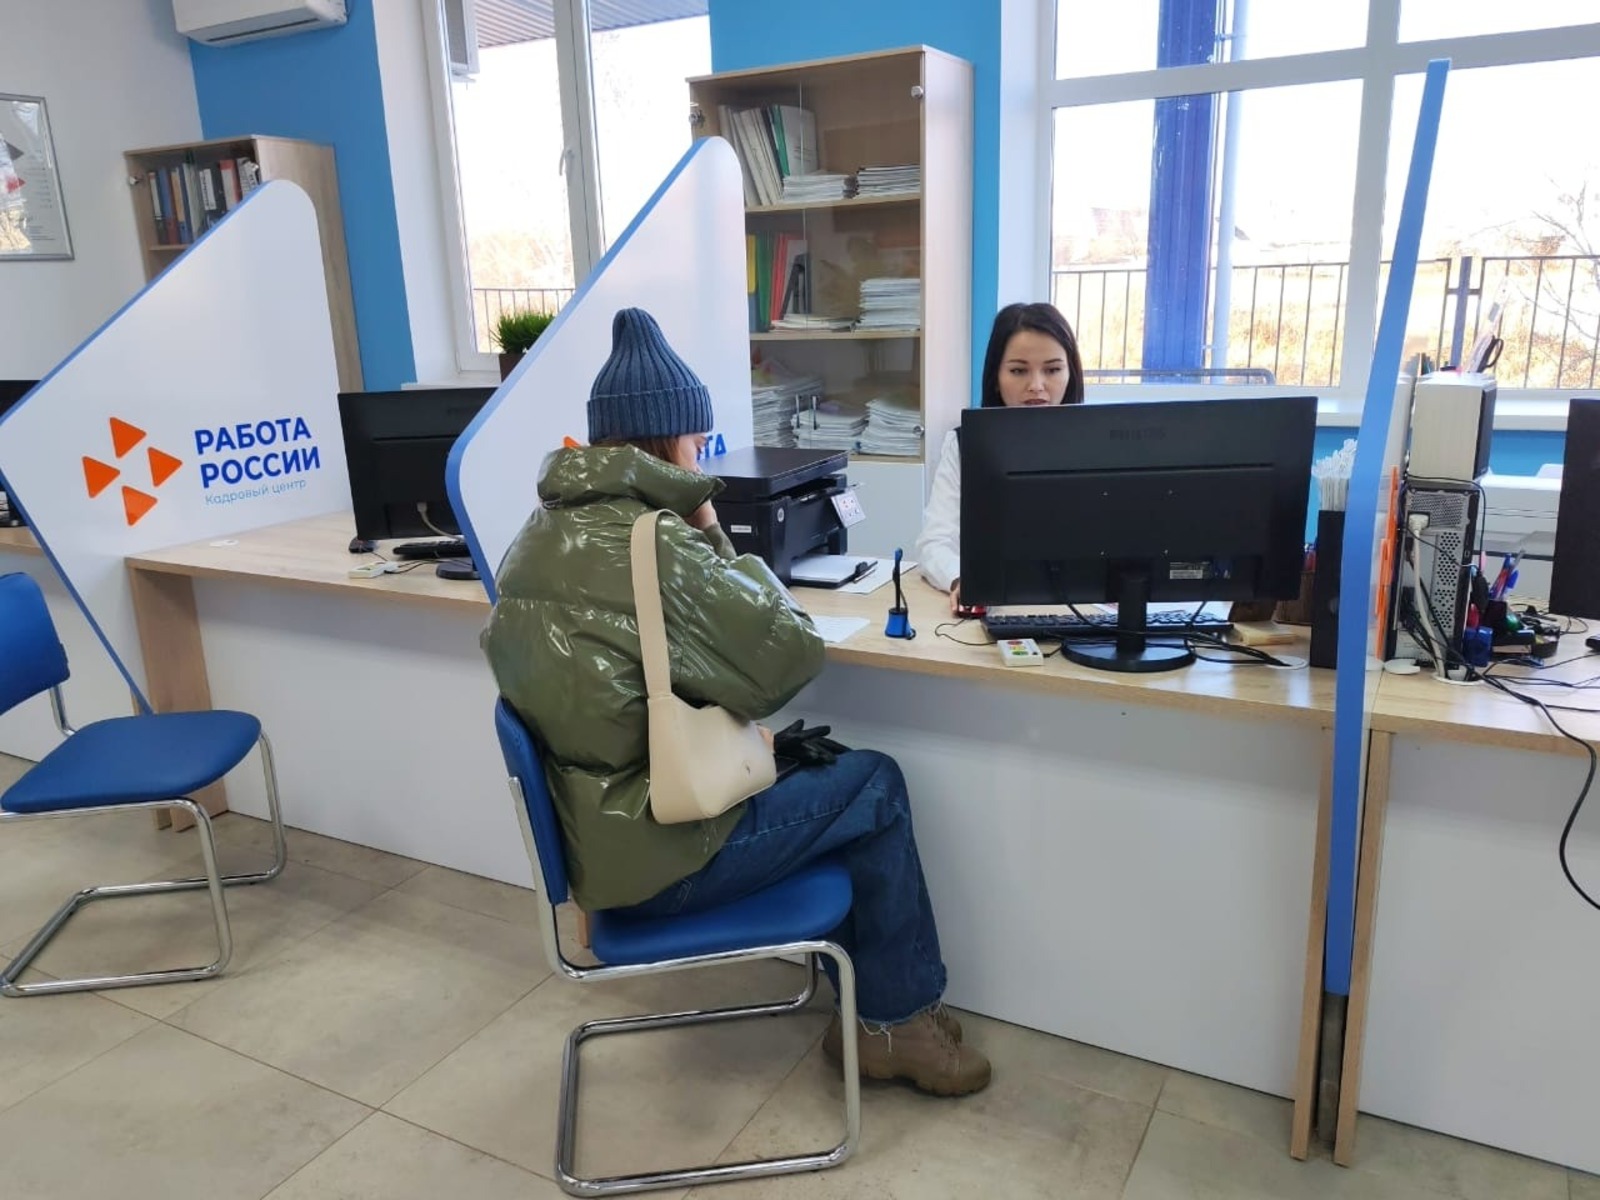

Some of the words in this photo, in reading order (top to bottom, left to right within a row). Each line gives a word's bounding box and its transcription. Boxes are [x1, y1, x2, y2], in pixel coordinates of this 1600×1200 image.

[195, 417, 312, 455] РАБОТА
[200, 446, 320, 488] РОССИИ
[205, 484, 269, 505] Кадровый
[272, 480, 306, 494] центр
